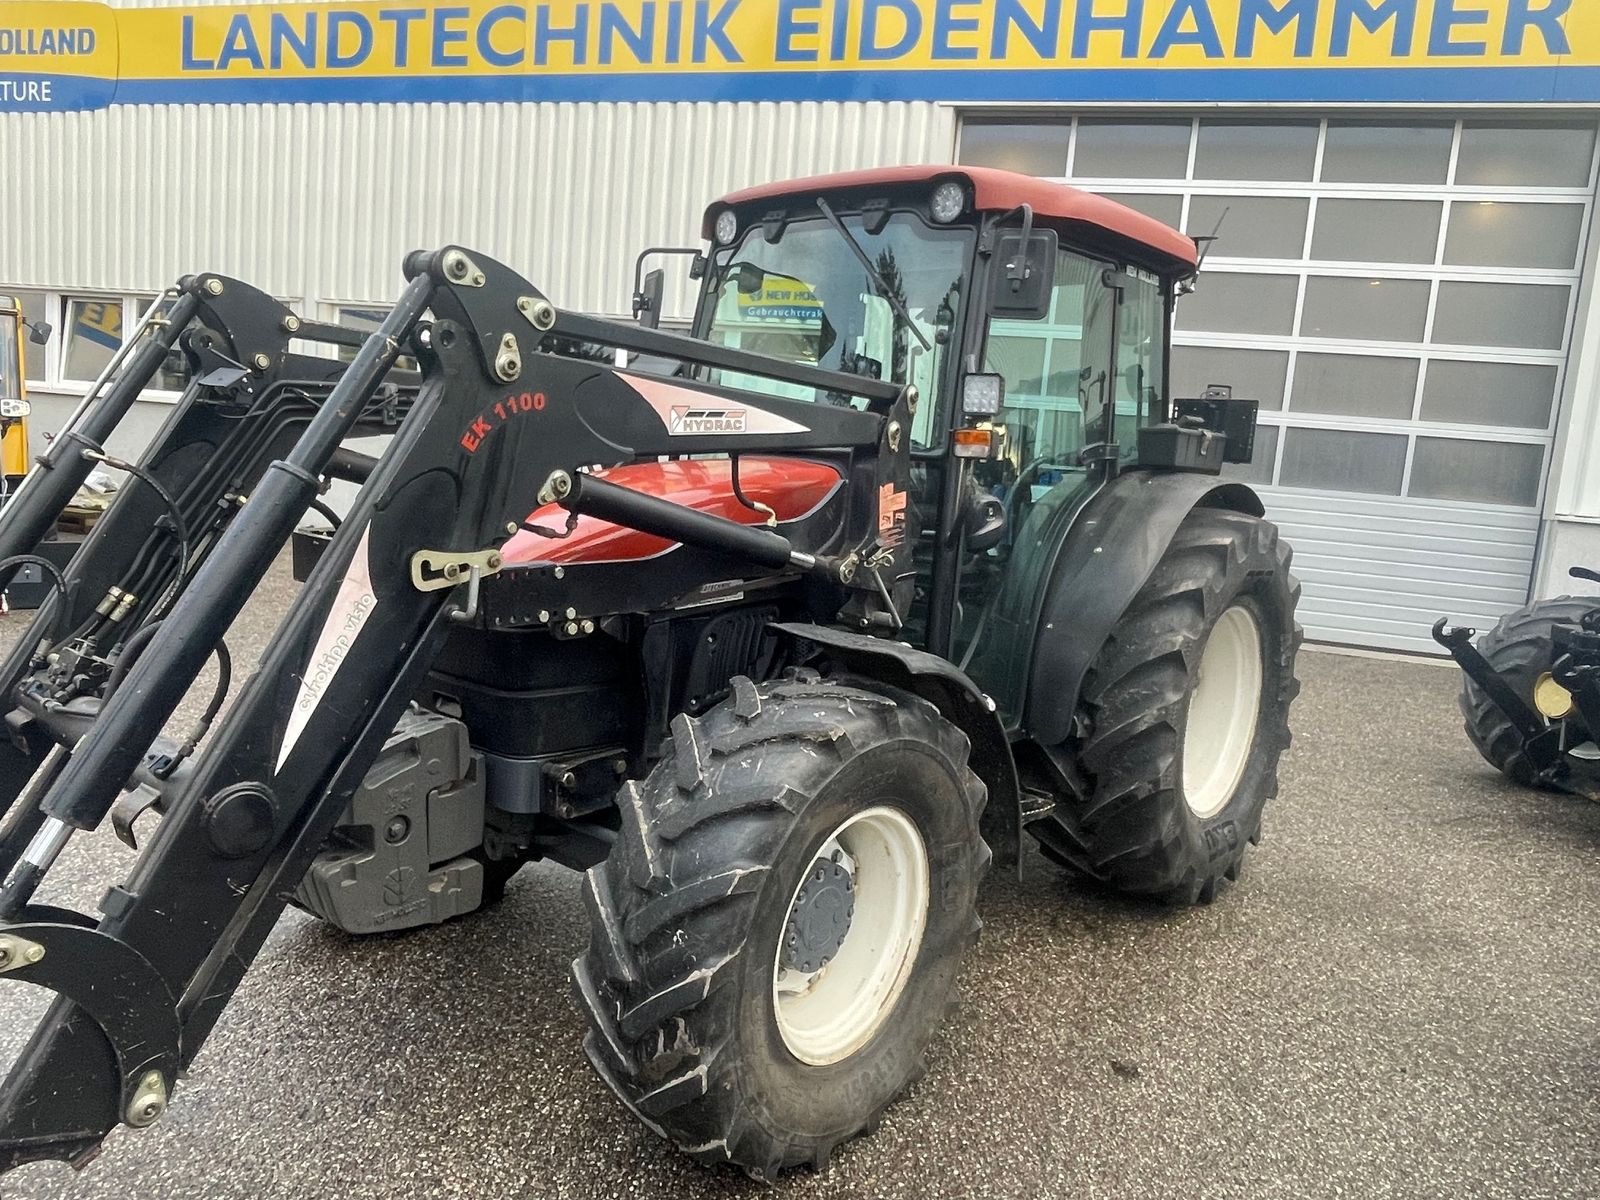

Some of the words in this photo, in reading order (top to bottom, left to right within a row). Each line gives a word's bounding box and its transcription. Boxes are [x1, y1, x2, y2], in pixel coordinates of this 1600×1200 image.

[182, 0, 742, 69] LANDTECHNIK
[775, 0, 1570, 61] EIDENHAMMER
[460, 415, 492, 453] EK
[494, 392, 546, 420] 1100
[683, 419, 743, 431] HYDRAC
